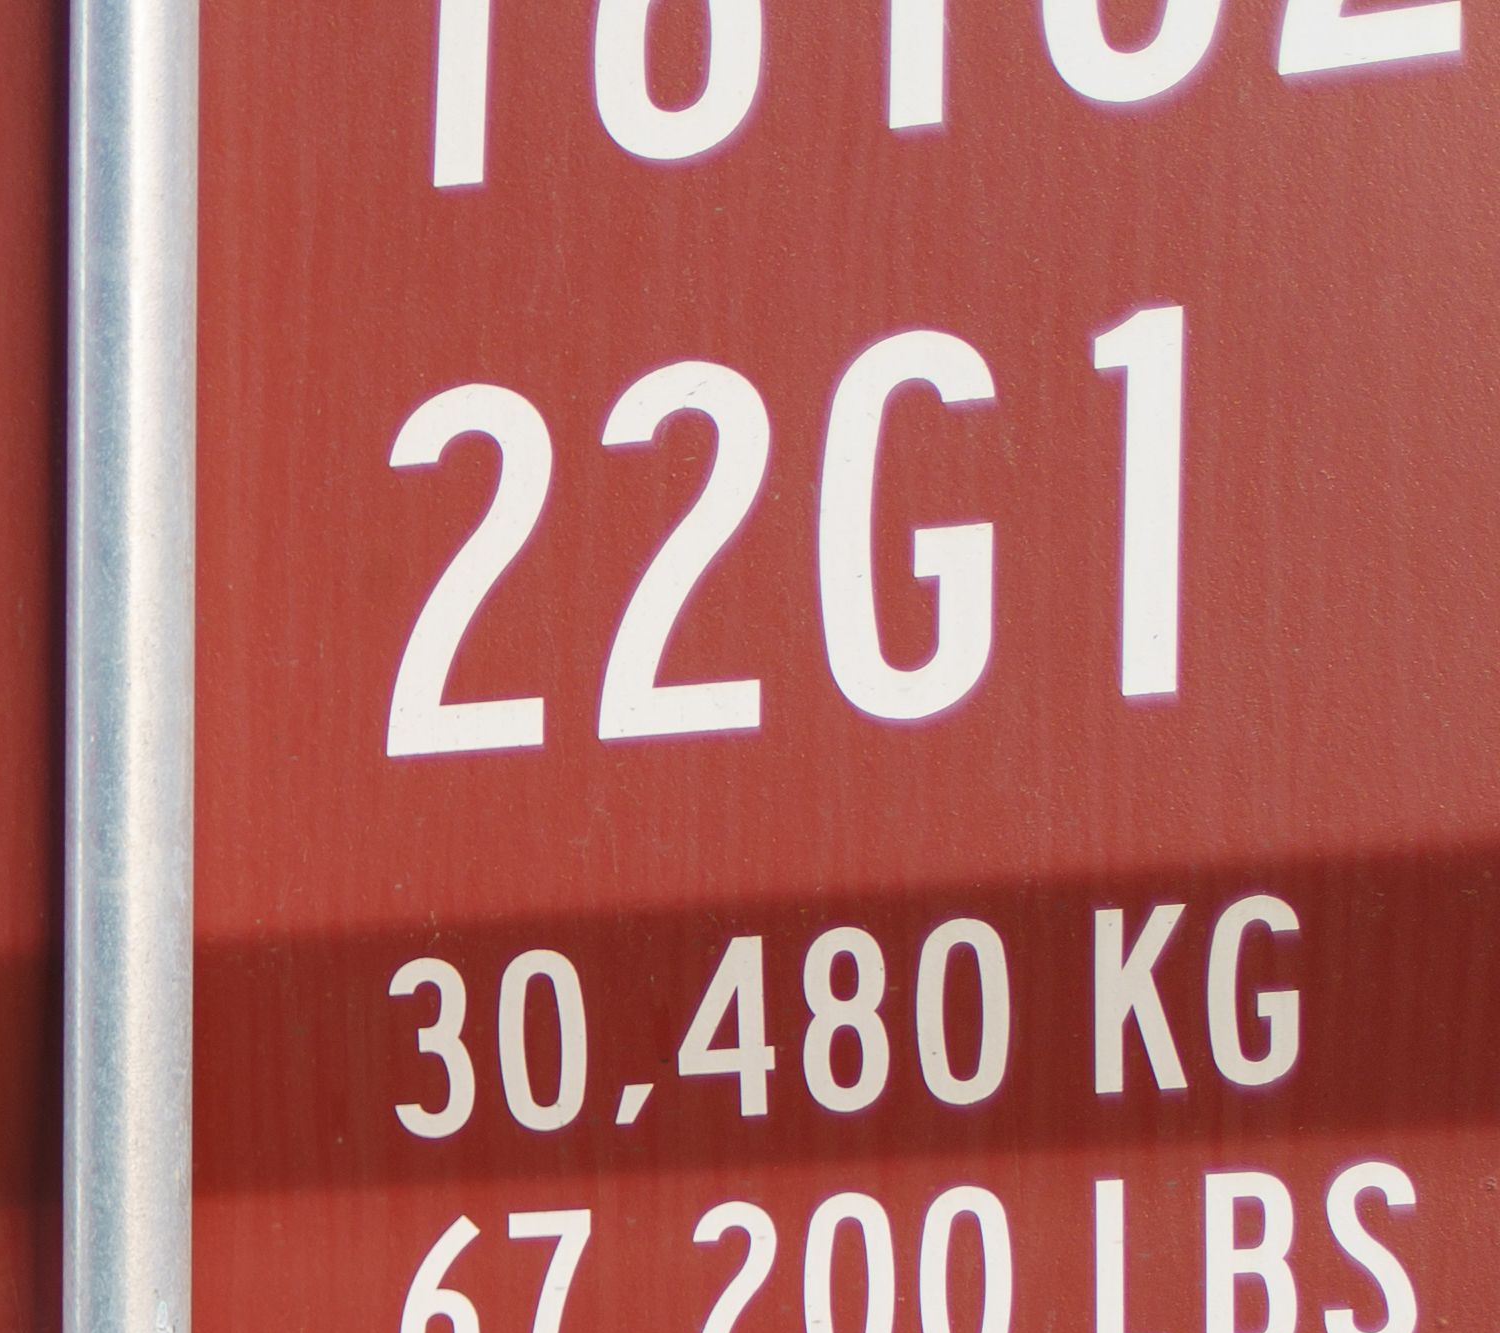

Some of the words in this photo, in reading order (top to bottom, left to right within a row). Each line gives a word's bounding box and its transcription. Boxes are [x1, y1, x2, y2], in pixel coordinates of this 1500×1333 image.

[385, 304, 1186, 758] 22G1
[388, 917, 1011, 1139] 30,480
[1094, 893, 1301, 1095] KG
